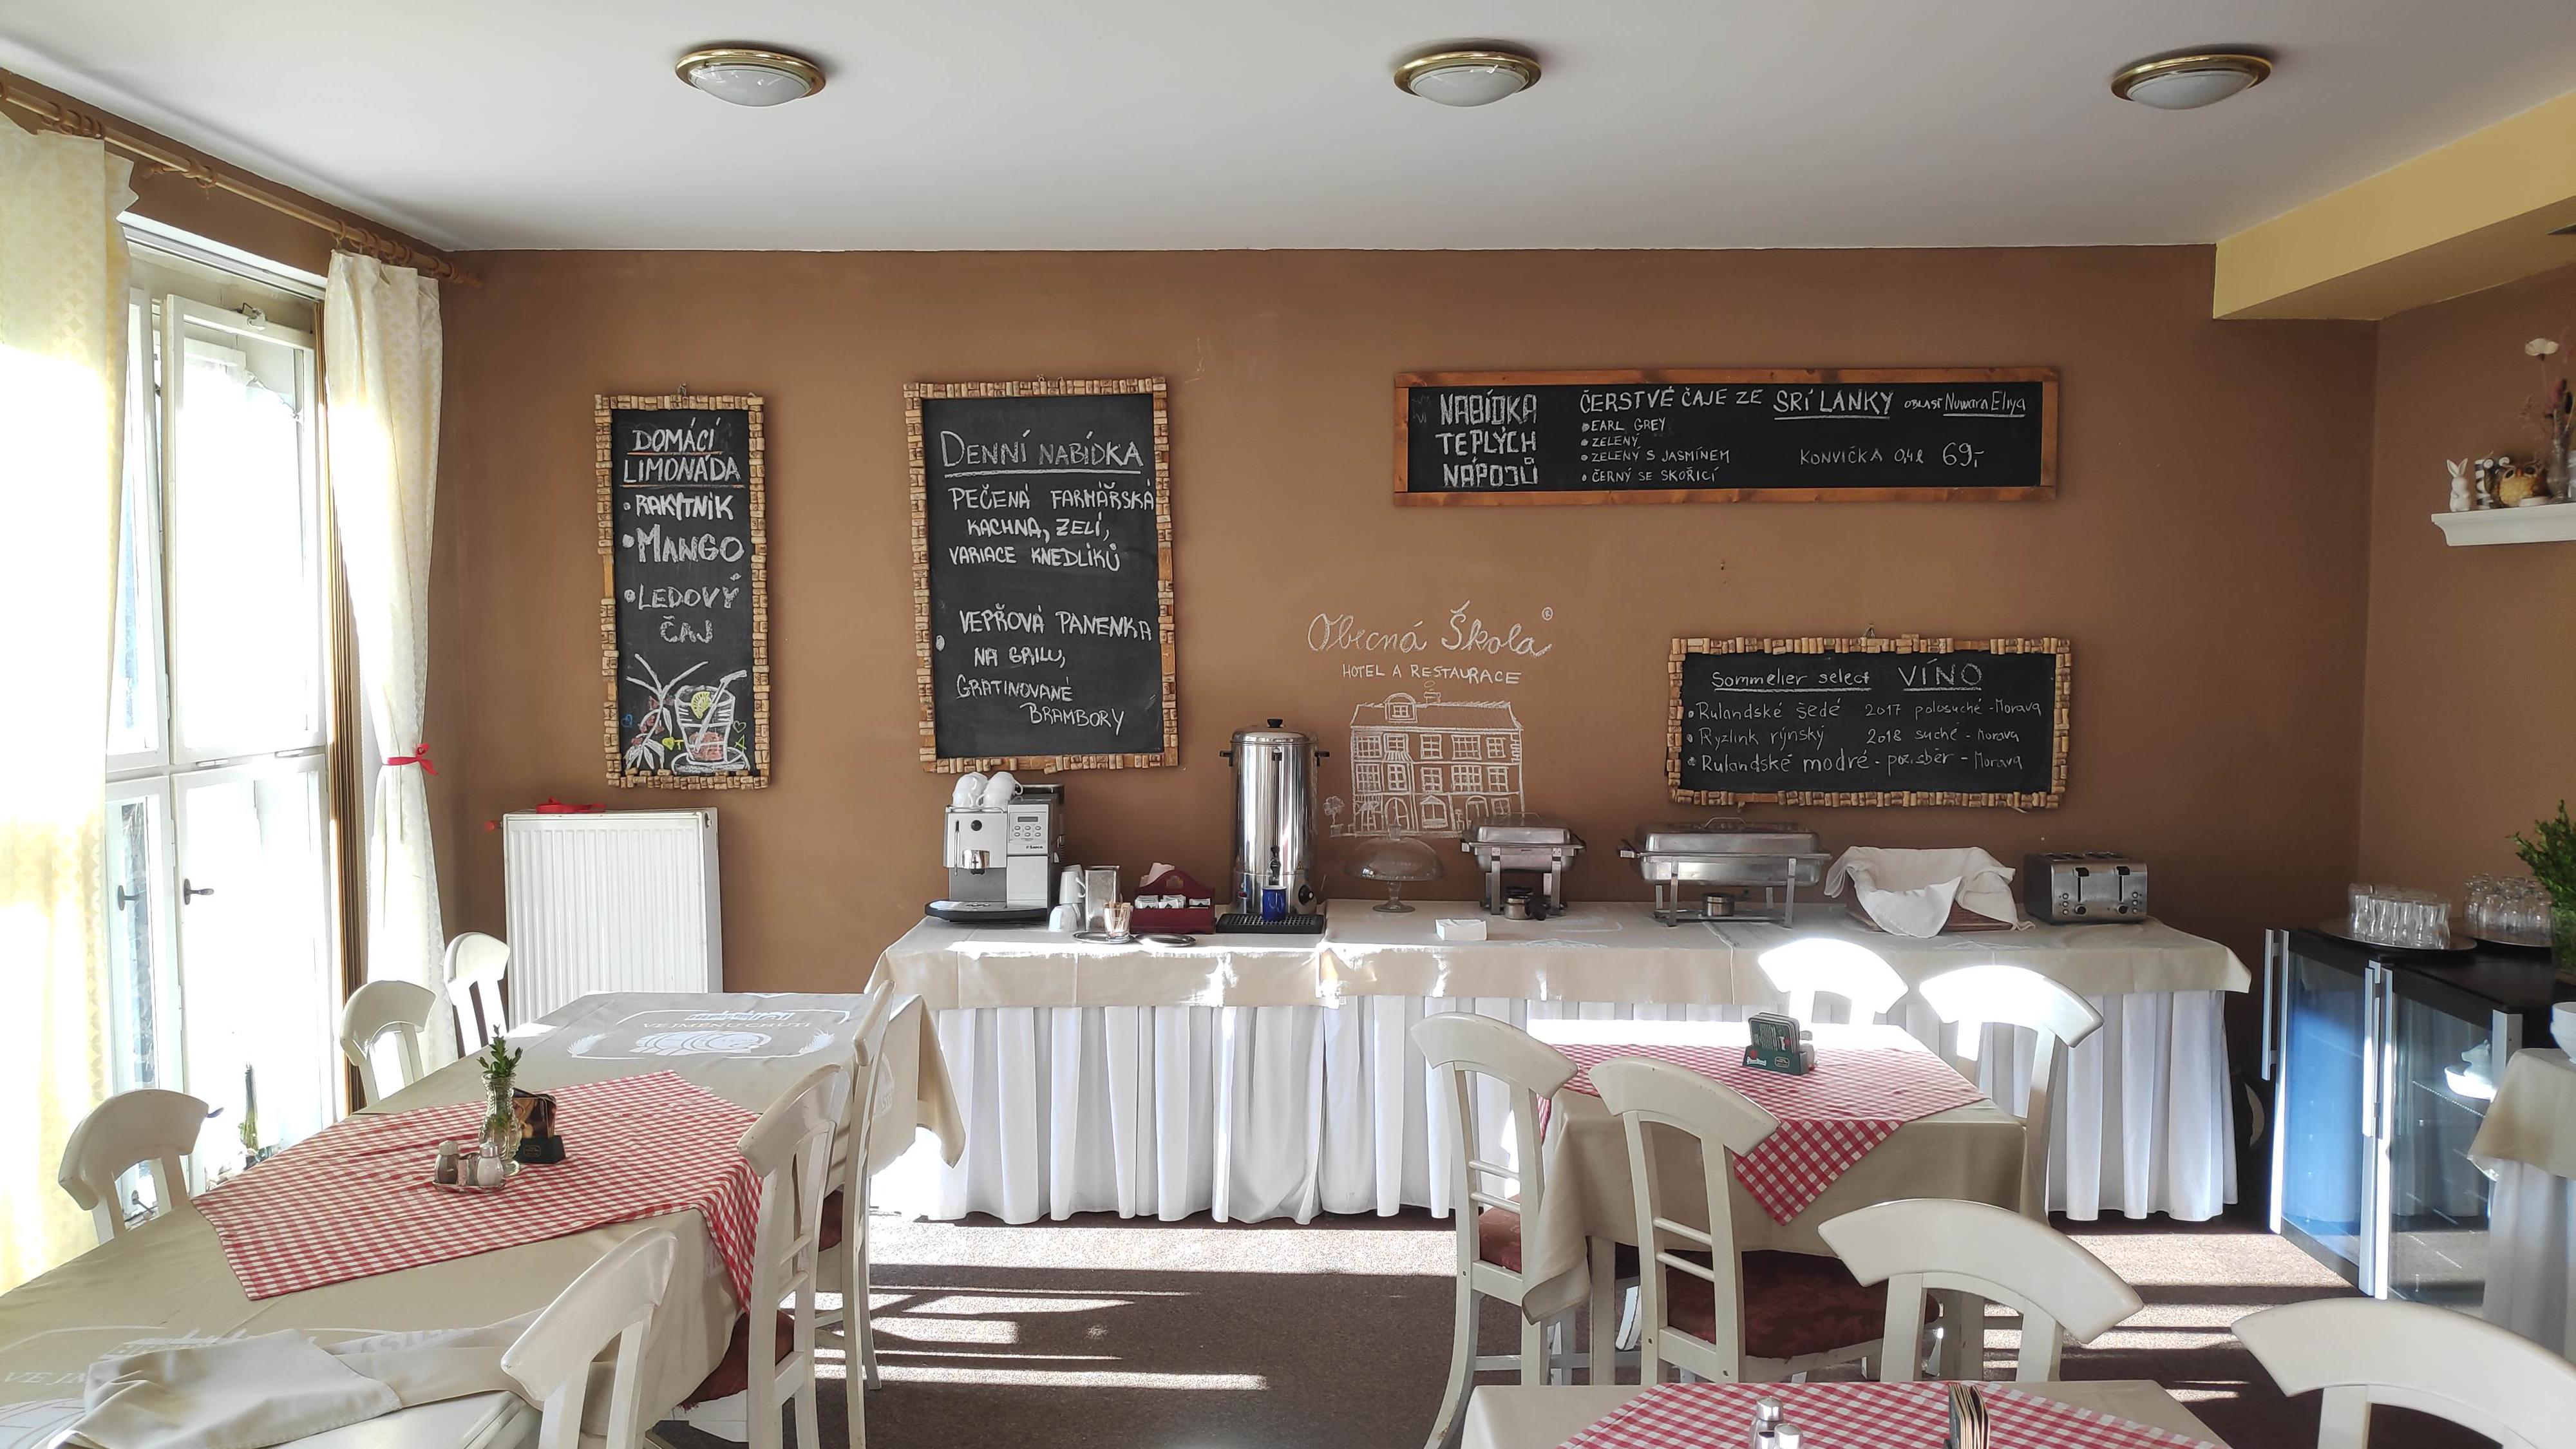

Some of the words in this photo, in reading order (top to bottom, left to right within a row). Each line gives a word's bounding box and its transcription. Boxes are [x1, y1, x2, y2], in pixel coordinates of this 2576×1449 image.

[1439, 388, 1537, 425] NABÍDKA
[1580, 386, 1675, 413] ČERSTVÉ
[1681, 387, 1727, 408] ČAJE
[1736, 389, 1763, 404] ZE
[1820, 389, 1893, 415] LANKY
[1945, 392, 1988, 411] Nuwara
[632, 417, 721, 453] DOMÁCÍ
[1591, 420, 1625, 431] EARL
[1634, 417, 1666, 431] GREY
[940, 428, 1031, 468] DENNÍ
[1037, 431, 1144, 466] NABÍDKA
[1435, 426, 1537, 456] TEPLÝCH
[1591, 433, 1640, 447] ZELENÝ
[1591, 446, 1642, 462] ZELENÝ
[1646, 450, 1655, 461] S
[1661, 446, 1730, 464] JASMÍNEM
[623, 453, 741, 484] LIMONÁDA
[1800, 446, 1883, 465] KONVIČKA
[1443, 456, 1538, 488] NÁPOJŮ
[1591, 467, 1632, 482] ČERNÝ
[1638, 471, 1653, 481] SE
[1661, 466, 1720, 482] SKOŘICÍ
[947, 483, 1031, 511] PEČENÁ
[1050, 478, 1155, 511] FARMÁŘSKÁ
[967, 516, 1051, 544] KACHNA,
[1056, 511, 1110, 542] ZELÍ,
[948, 545, 1018, 565] VARIACE
[1031, 542, 1121, 572] KNEDLÍKŮ
[638, 573, 741, 610] LEDOVÝ
[659, 614, 714, 644] ČAJ
[959, 603, 1046, 635] VEPŘOVÁ
[1055, 611, 1152, 641] PANENKA
[1307, 612, 1428, 653] Obecná
[1440, 599, 1553, 658] Škola
[974, 647, 998, 667] NA
[1009, 646, 1066, 669] GRILU,
[1341, 663, 1386, 677] HOTEL
[1392, 664, 1403, 677] A
[1410, 664, 1522, 685] RESTAURACE
[1710, 667, 1808, 688] Sommelier
[1818, 668, 1870, 687] select
[1897, 658, 1982, 687] VÍNO
[956, 674, 1074, 703] GRATINOVANÉ
[1019, 701, 1124, 737] BRAMBORY
[1696, 701, 1784, 721] Rulandské
[1795, 697, 1841, 719] šedé
[1865, 703, 1901, 717] 2017
[1913, 697, 1984, 720] polosuché
[1698, 727, 1759, 752] Ryzlink
[1867, 728, 1902, 744] 2018
[1914, 721, 1958, 741] suché
[1977, 728, 2020, 743] Morava
[1702, 753, 1794, 773] Rulandské
[1803, 748, 1870, 772] modré
[1974, 751, 2023, 770] Morava
